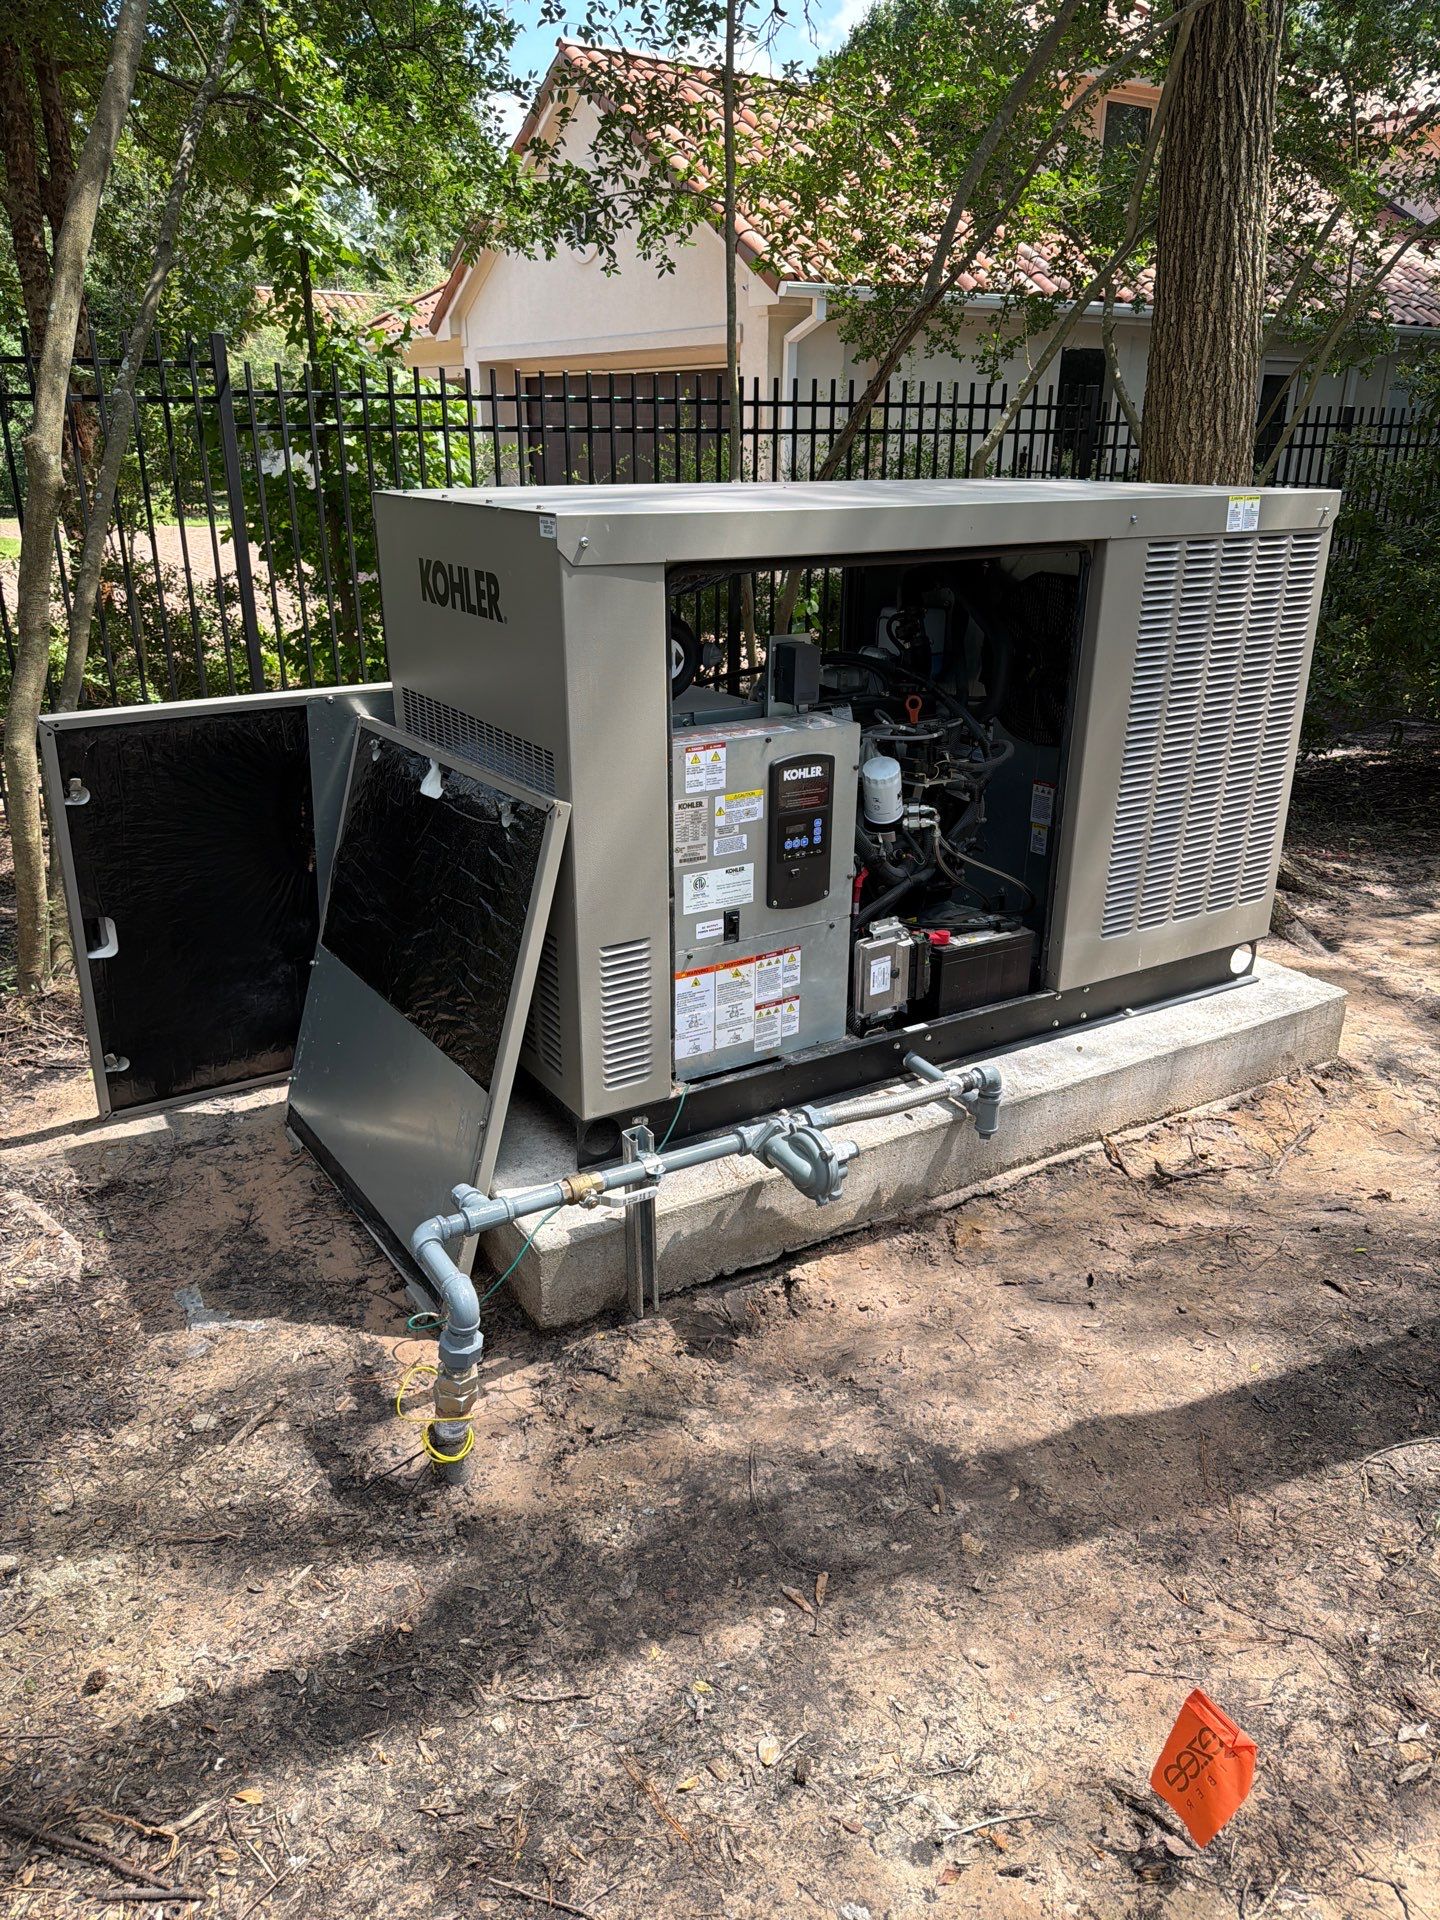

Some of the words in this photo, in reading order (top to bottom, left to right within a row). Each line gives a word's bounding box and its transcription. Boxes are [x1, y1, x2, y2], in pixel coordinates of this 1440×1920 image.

[419, 557, 504, 624] KOHLER
[783, 765, 822, 782] KOHLER
[678, 801, 703, 810] KOHLER
[725, 866, 745, 874] KOHLER
